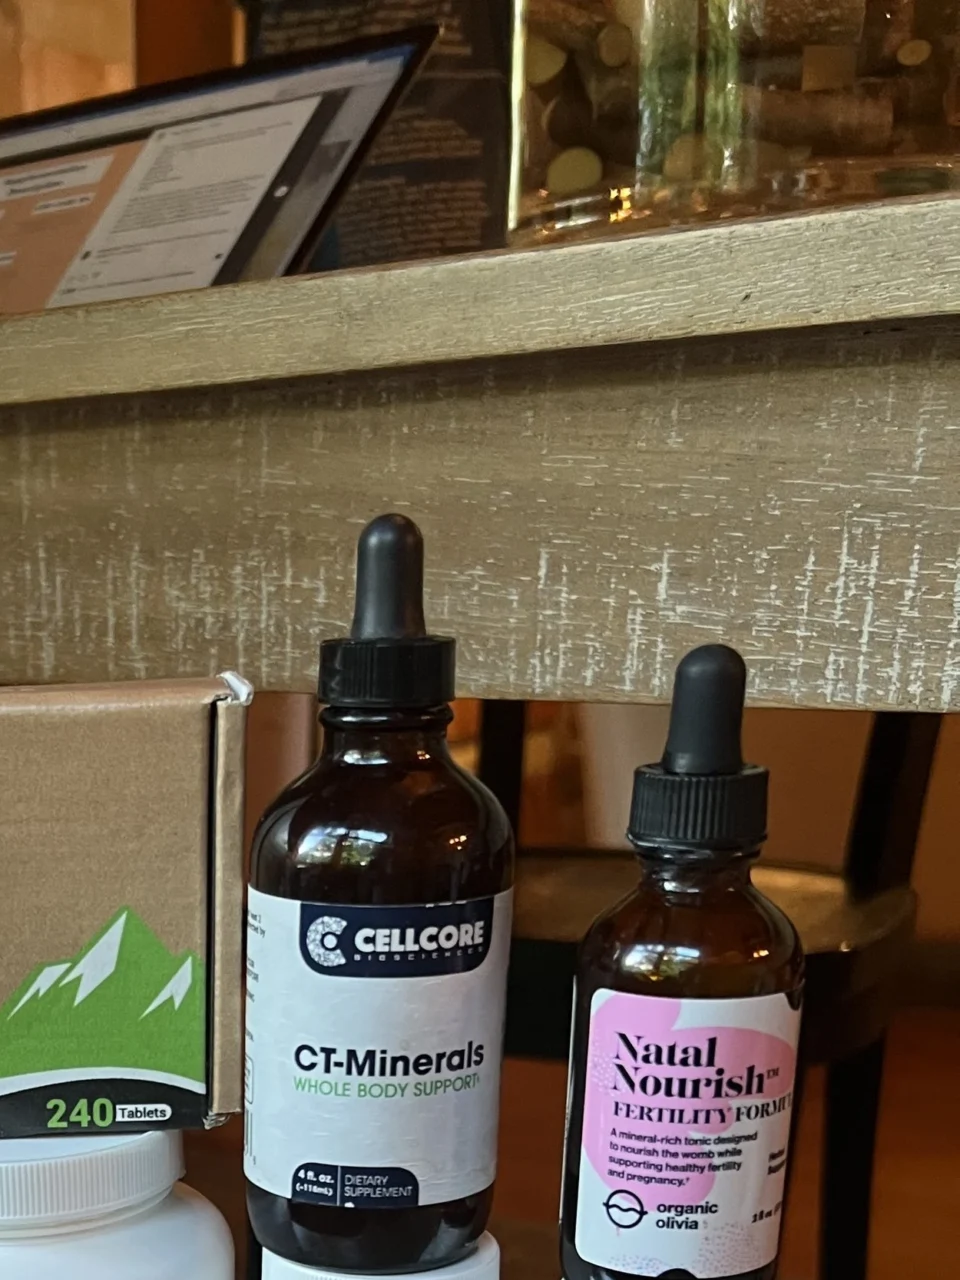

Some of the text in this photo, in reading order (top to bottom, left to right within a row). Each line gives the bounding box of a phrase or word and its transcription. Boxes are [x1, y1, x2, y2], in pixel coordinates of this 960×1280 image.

[354, 920, 485, 953] CELLCORE
[294, 1040, 485, 1077] CT-Minerals
[613, 1031, 717, 1067] Natal
[293, 1073, 478, 1099] WHOLE BODY SUPPORT
[46, 1098, 167, 1129] 240 Tablets
[613, 1100, 728, 1125] FERTILITY
[610, 1128, 758, 1146] A mineral-rich tonic designed
[609, 1141, 743, 1159] to nourish the womb while
[607, 1167, 625, 1179] and
[608, 1155, 743, 1175] supporting healthy fertility
[344, 1174, 389, 1186] DIETARY
[343, 1185, 413, 1198] SUPPLEMENT
[656, 1201, 719, 1216] organic
[655, 1217, 699, 1230] olivia
